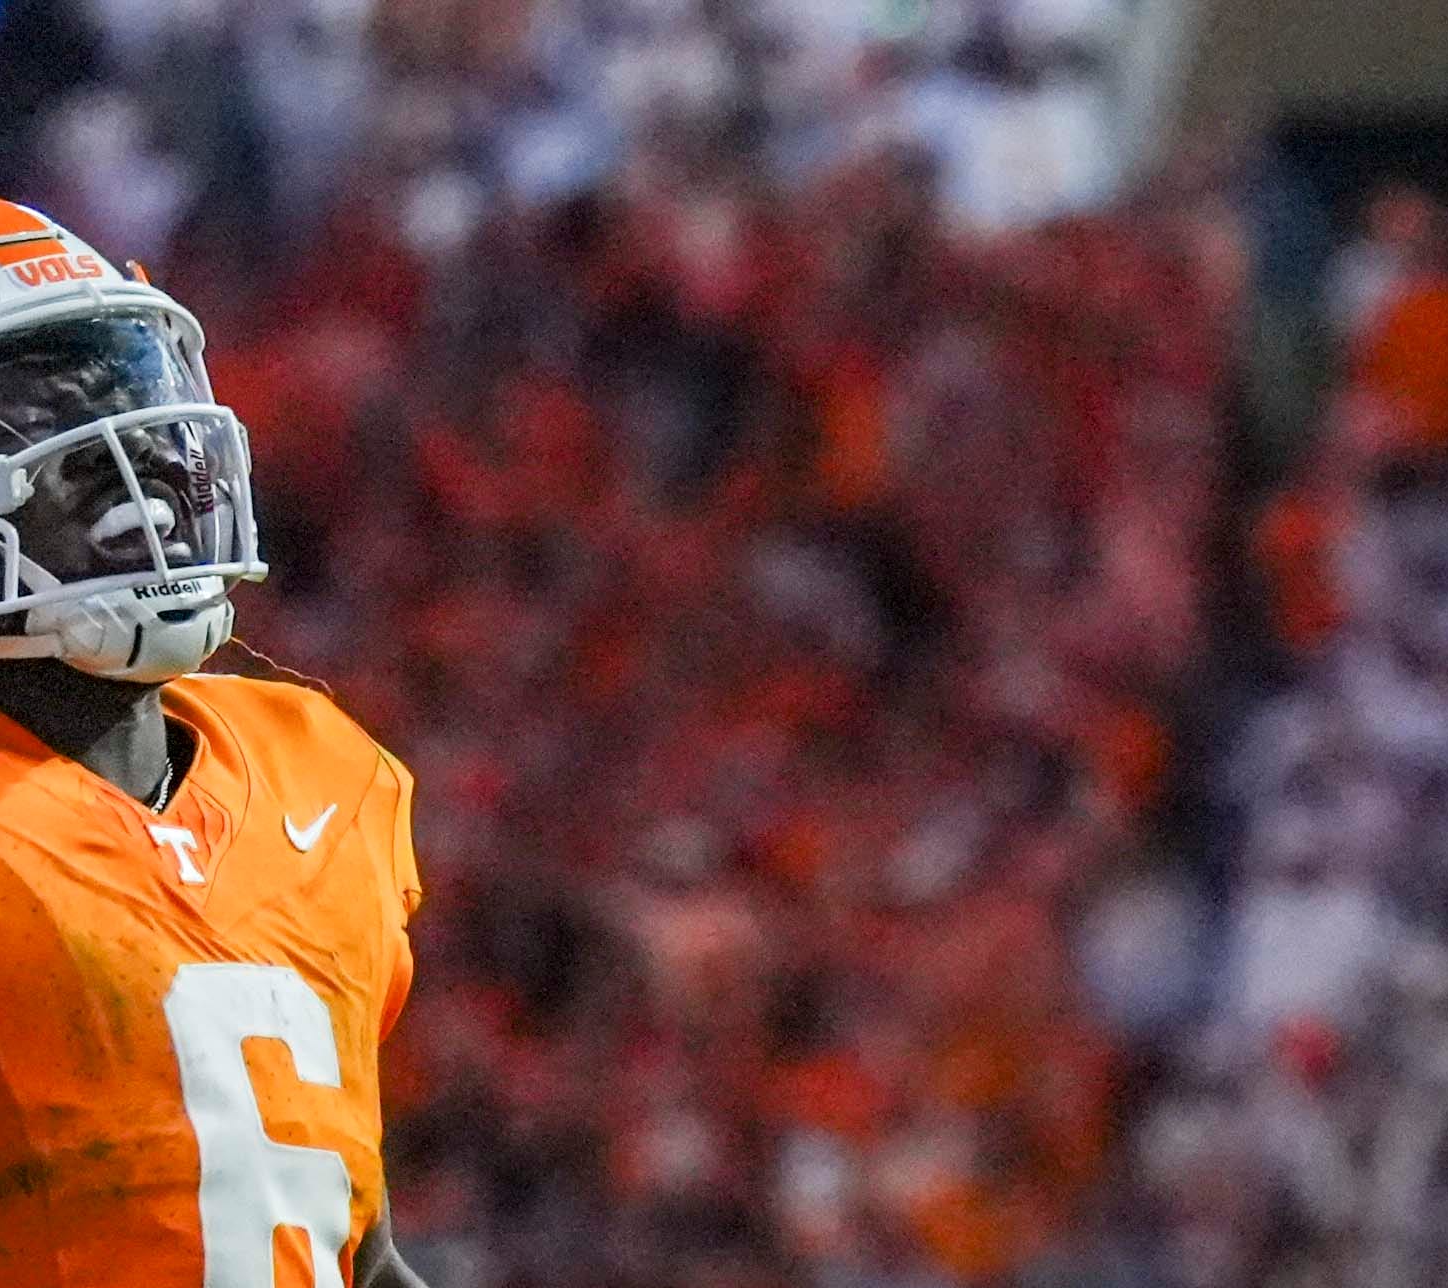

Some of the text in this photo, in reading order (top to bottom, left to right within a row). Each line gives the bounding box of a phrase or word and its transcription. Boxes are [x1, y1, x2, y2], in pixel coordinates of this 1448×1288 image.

[13, 254, 104, 287] VOLS
[132, 580, 203, 600] Riddell
[149, 824, 207, 885] T
